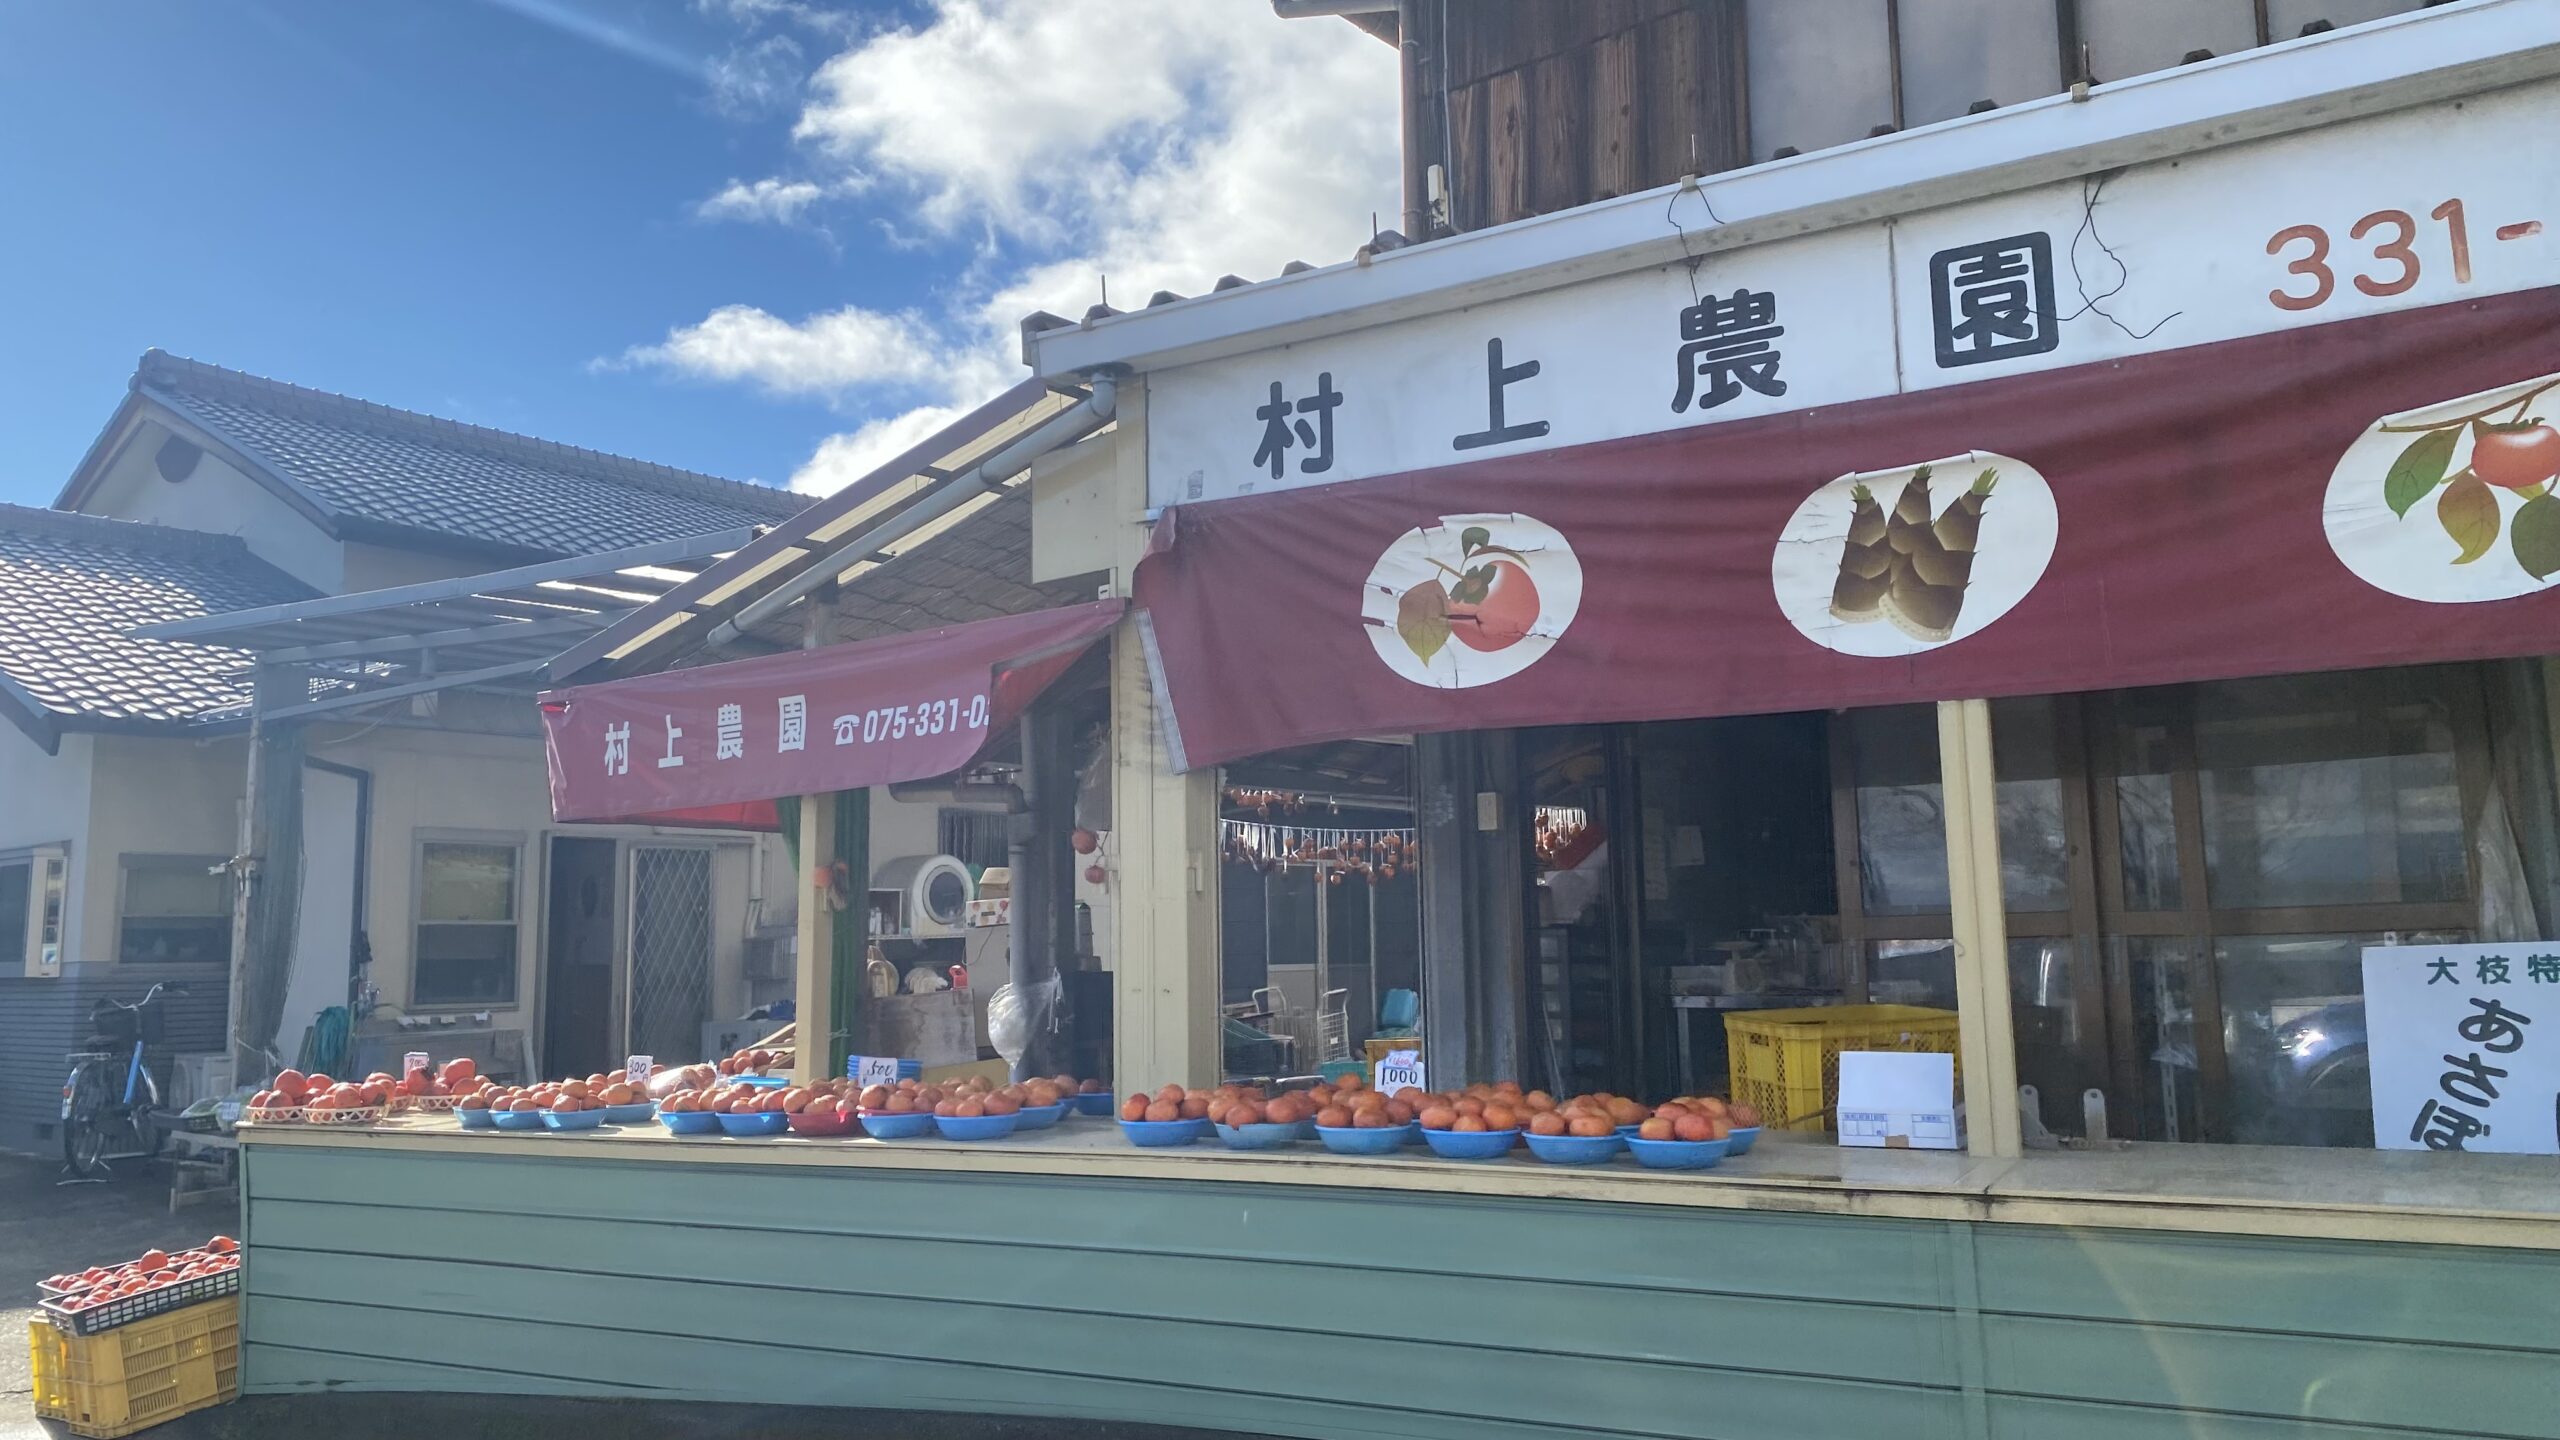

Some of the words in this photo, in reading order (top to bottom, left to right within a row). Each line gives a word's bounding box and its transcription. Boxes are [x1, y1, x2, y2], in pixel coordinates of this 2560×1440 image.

[1253, 231, 2059, 480] 村上農園
[604, 694, 806, 777] 村上農園
[863, 693, 990, 744] 075-331-0
